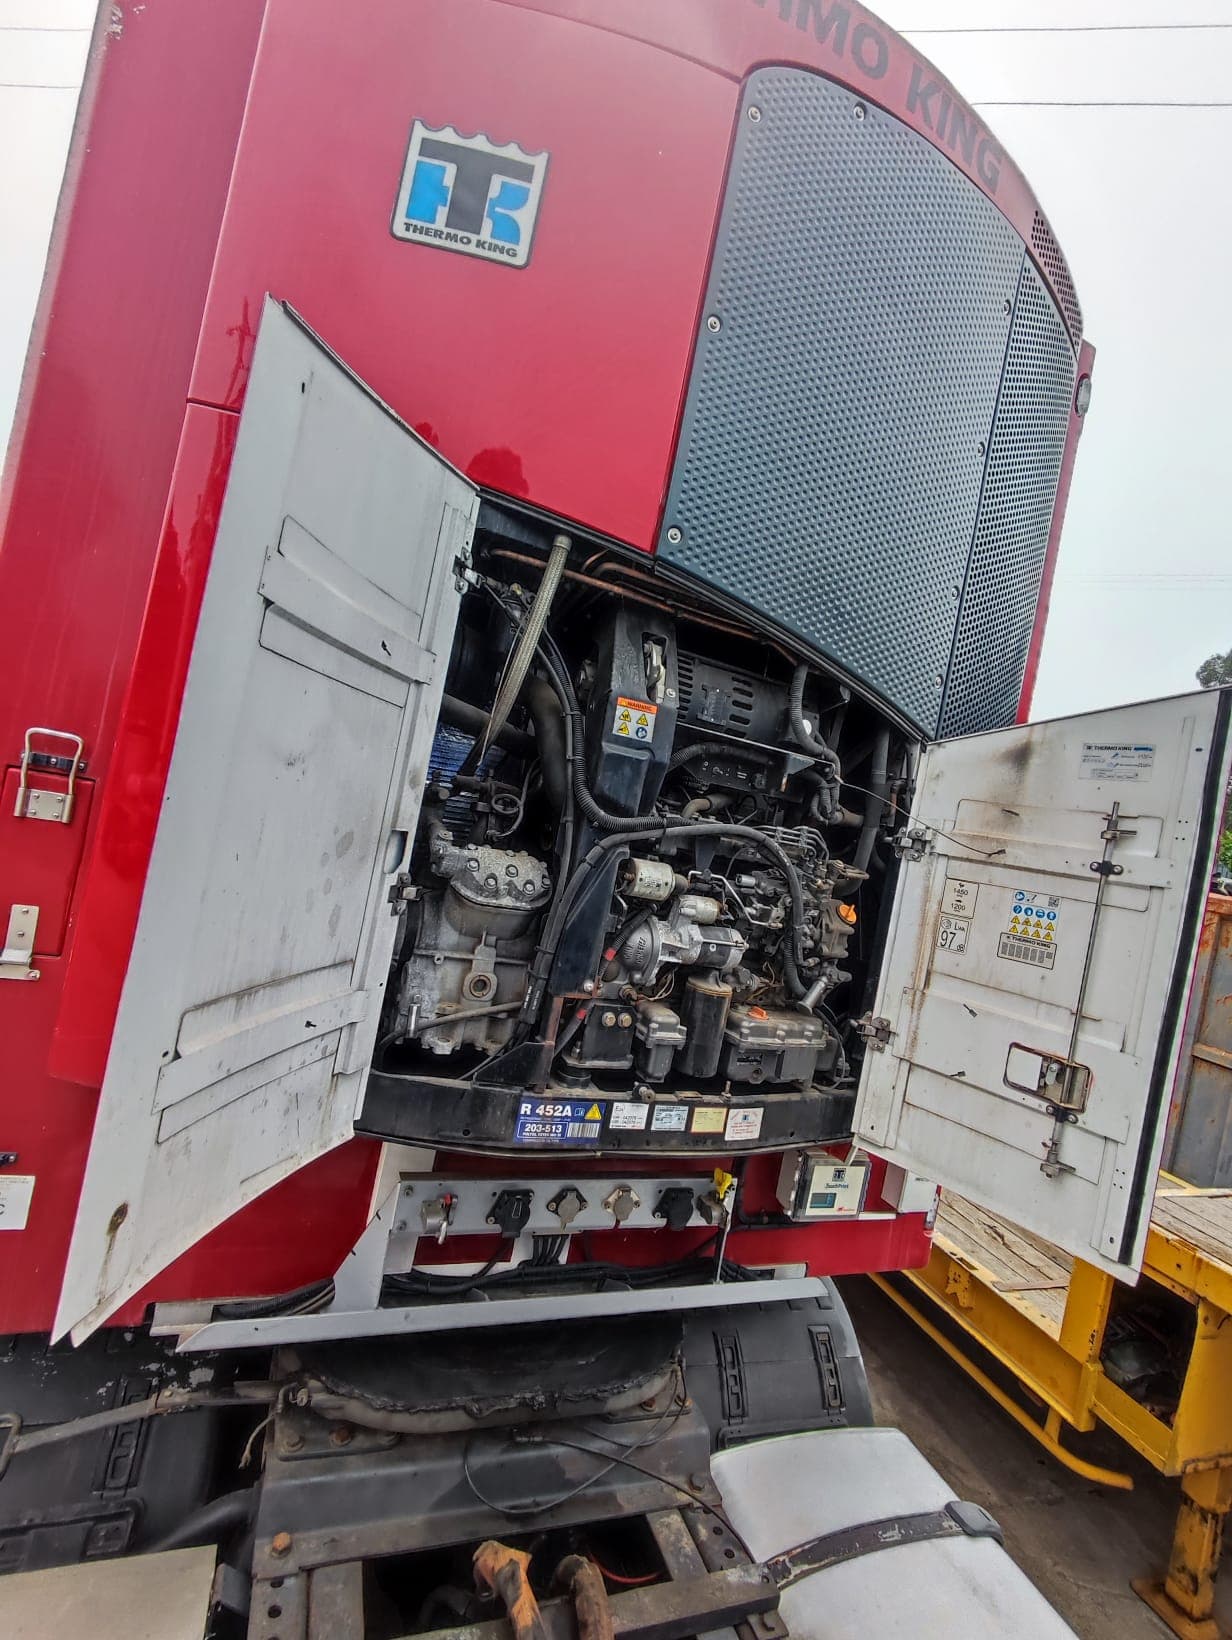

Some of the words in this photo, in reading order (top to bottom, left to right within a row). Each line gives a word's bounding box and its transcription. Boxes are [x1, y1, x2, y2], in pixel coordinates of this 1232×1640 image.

[905, 63, 1002, 195] KING
[403, 222, 472, 245] THERMO
[475, 239, 518, 258] KING
[940, 930, 957, 950] 97
[520, 1103, 532, 1115] R
[535, 1104, 572, 1117] 452A
[524, 1123, 562, 1133] 203-513
